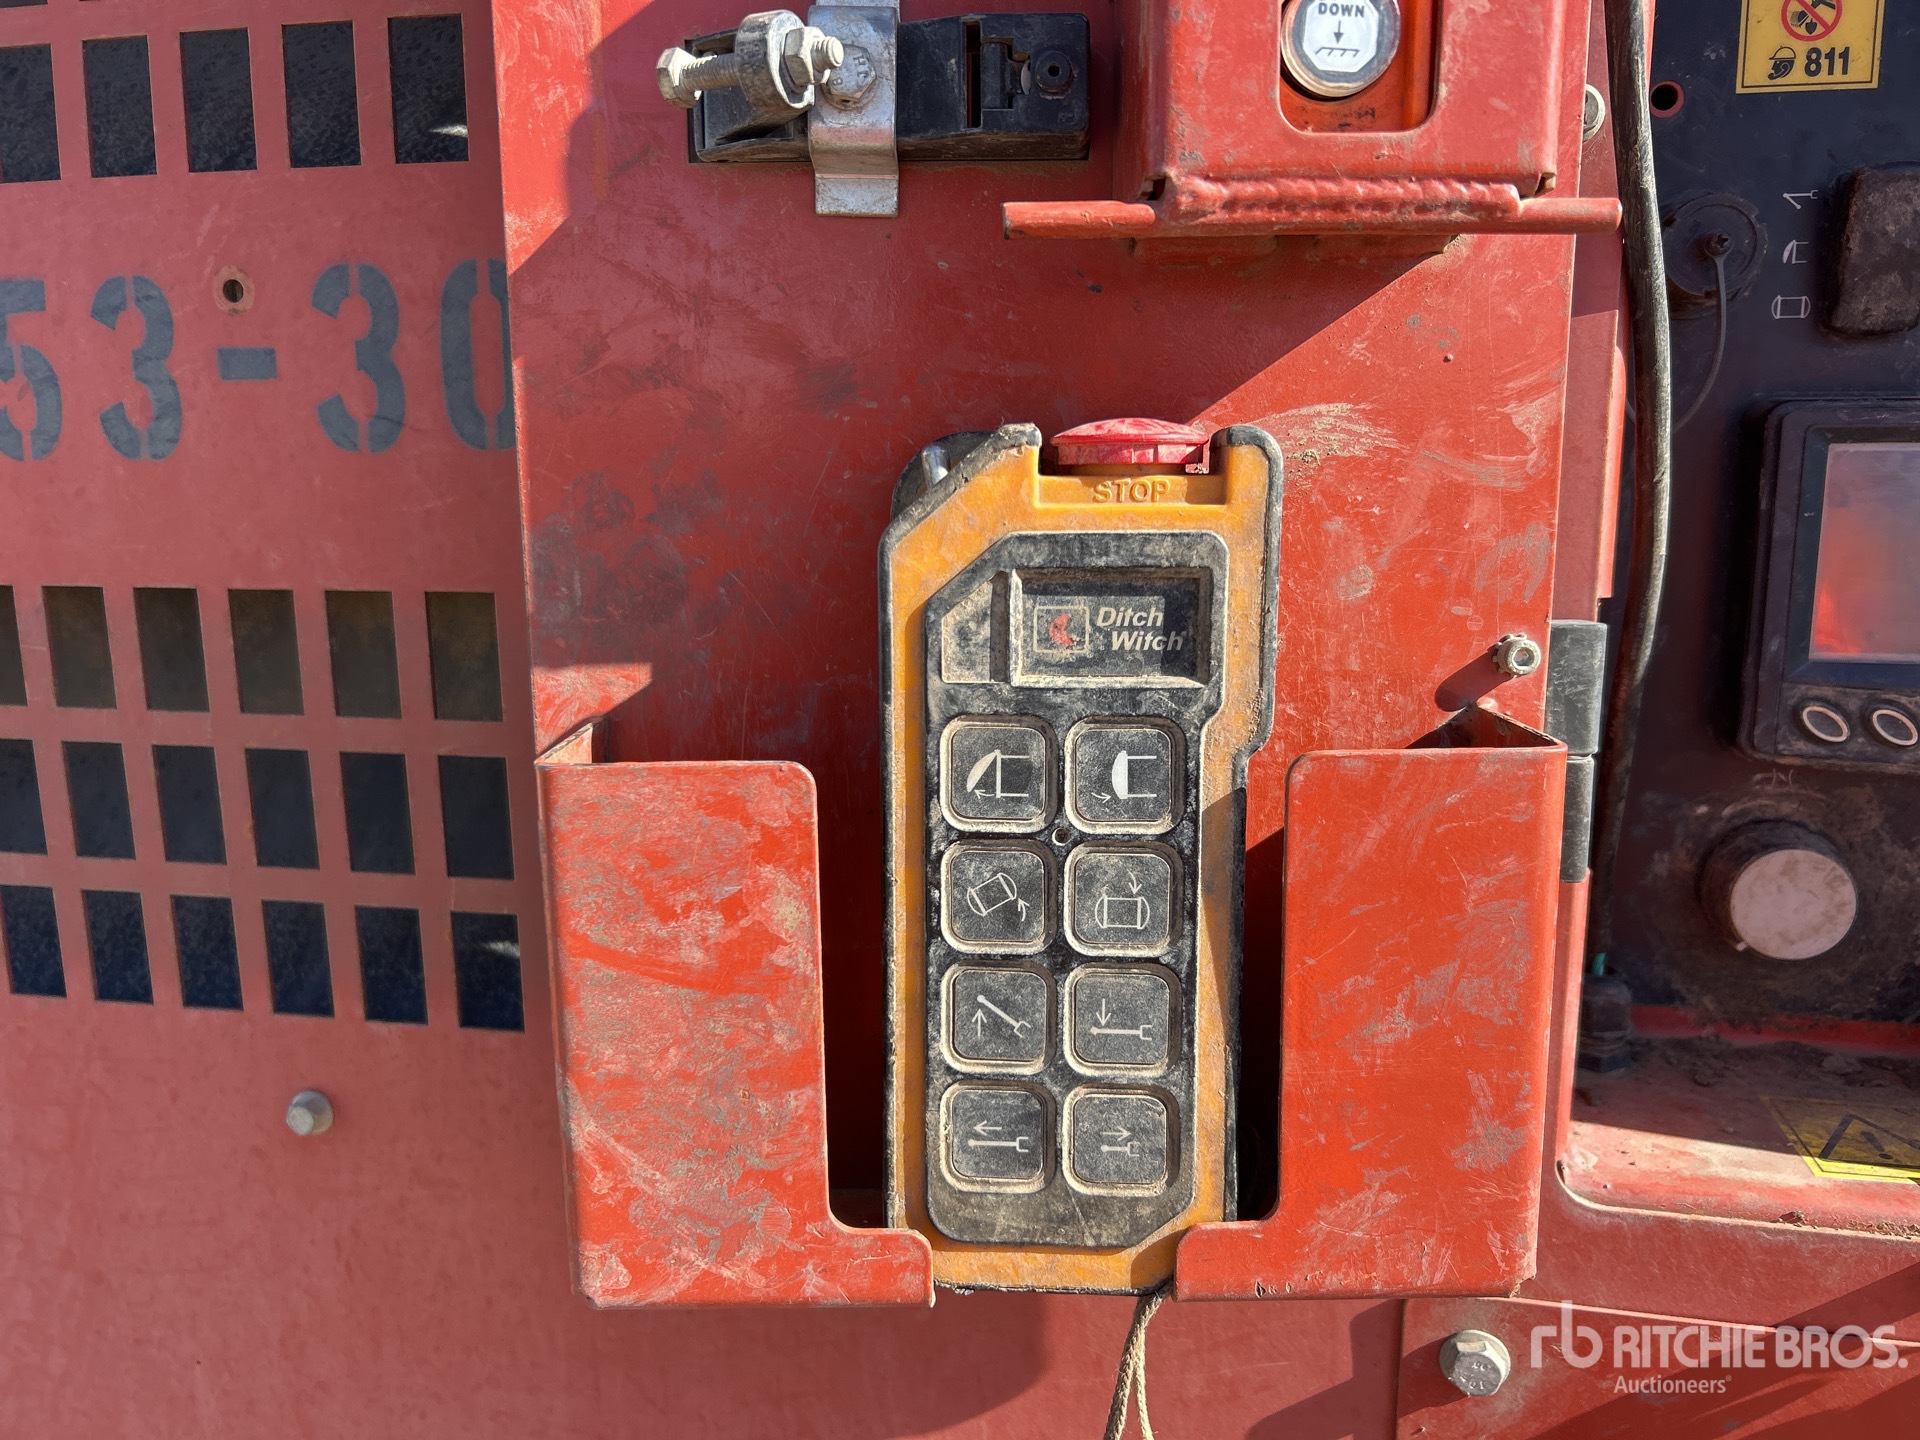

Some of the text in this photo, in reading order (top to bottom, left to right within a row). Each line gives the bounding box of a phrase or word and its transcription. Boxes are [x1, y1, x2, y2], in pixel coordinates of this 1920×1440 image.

[1318, 2, 1365, 18] DOWN
[1804, 46, 1851, 77] 811
[1093, 479, 1171, 503] STOP
[1096, 606, 1164, 627] Ditch
[1111, 630, 1185, 651] Witch
